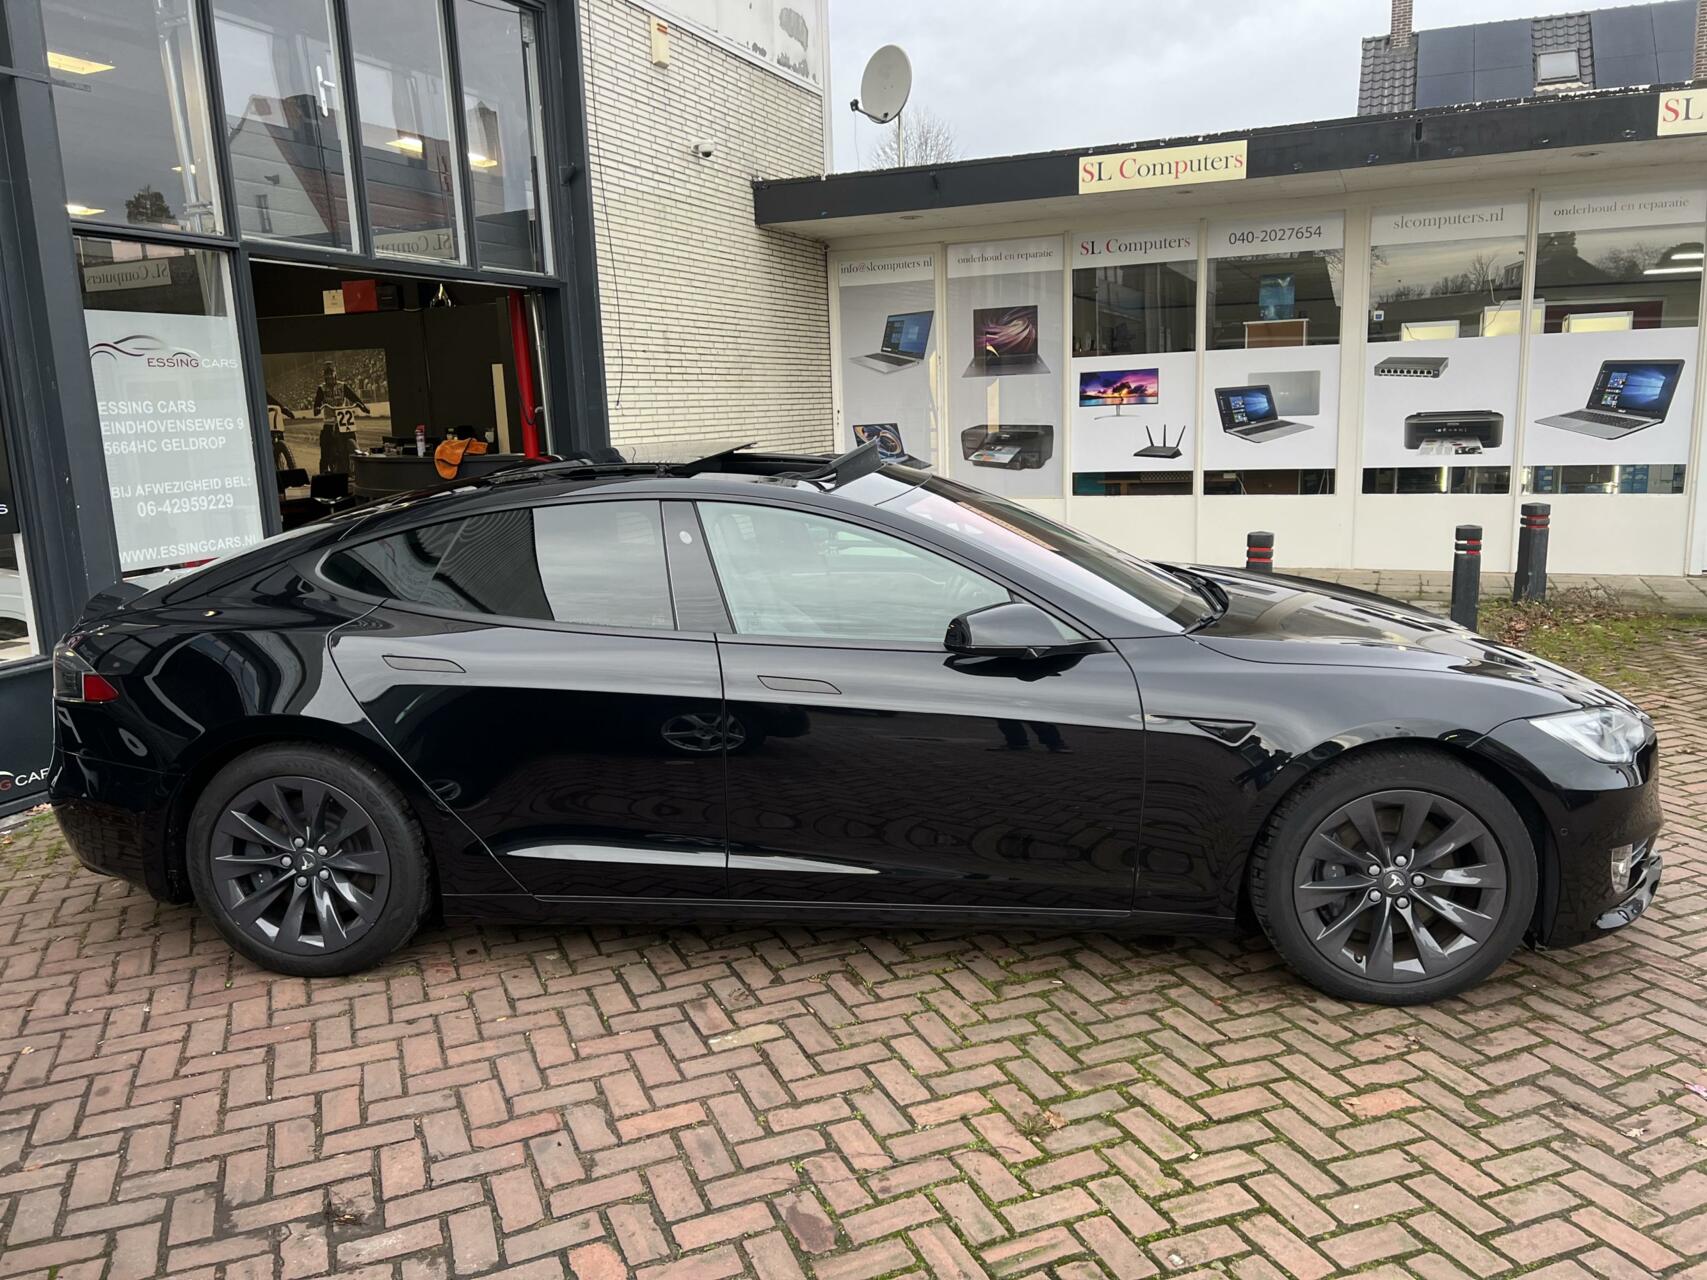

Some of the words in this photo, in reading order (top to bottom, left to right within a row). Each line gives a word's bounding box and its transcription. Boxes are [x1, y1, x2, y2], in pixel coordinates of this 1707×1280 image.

[1662, 97, 1704, 123] SL
[1081, 161, 1112, 183] SL
[1119, 153, 1244, 180] Computers
[1553, 202, 1617, 217] onderhoud
[1620, 202, 1635, 211] en
[1638, 196, 1689, 212] reparatie
[1393, 207, 1505, 230] slcomputers.nl
[1228, 225, 1322, 245] 040-2027654
[1080, 241, 1101, 256] SL
[1105, 236, 1191, 255] Computers
[840, 256, 932, 274] info@slcomputersnl
[957, 251, 1003, 265] onderhoud
[1004, 252, 1015, 261] en
[1016, 248, 1054, 260] reparatie
[147, 357, 199, 368] ESSING
[201, 358, 239, 369] CARS
[99, 401, 153, 415] ESSING
[157, 400, 197, 414] CARS
[101, 418, 234, 435] EINDHOVENSEWEG
[238, 418, 244, 430] 9
[337, 410, 355, 427] 22
[104, 439, 158, 455] 5664HC
[161, 436, 227, 451] GELDROP
[111, 486, 132, 499] BIJ
[135, 480, 222, 497] AFWEZIGHEID
[225, 476, 251, 489] BEL:
[137, 493, 234, 517] 06-42959229
[121, 535, 257, 564] WWW.ESSINGCARS.NL
